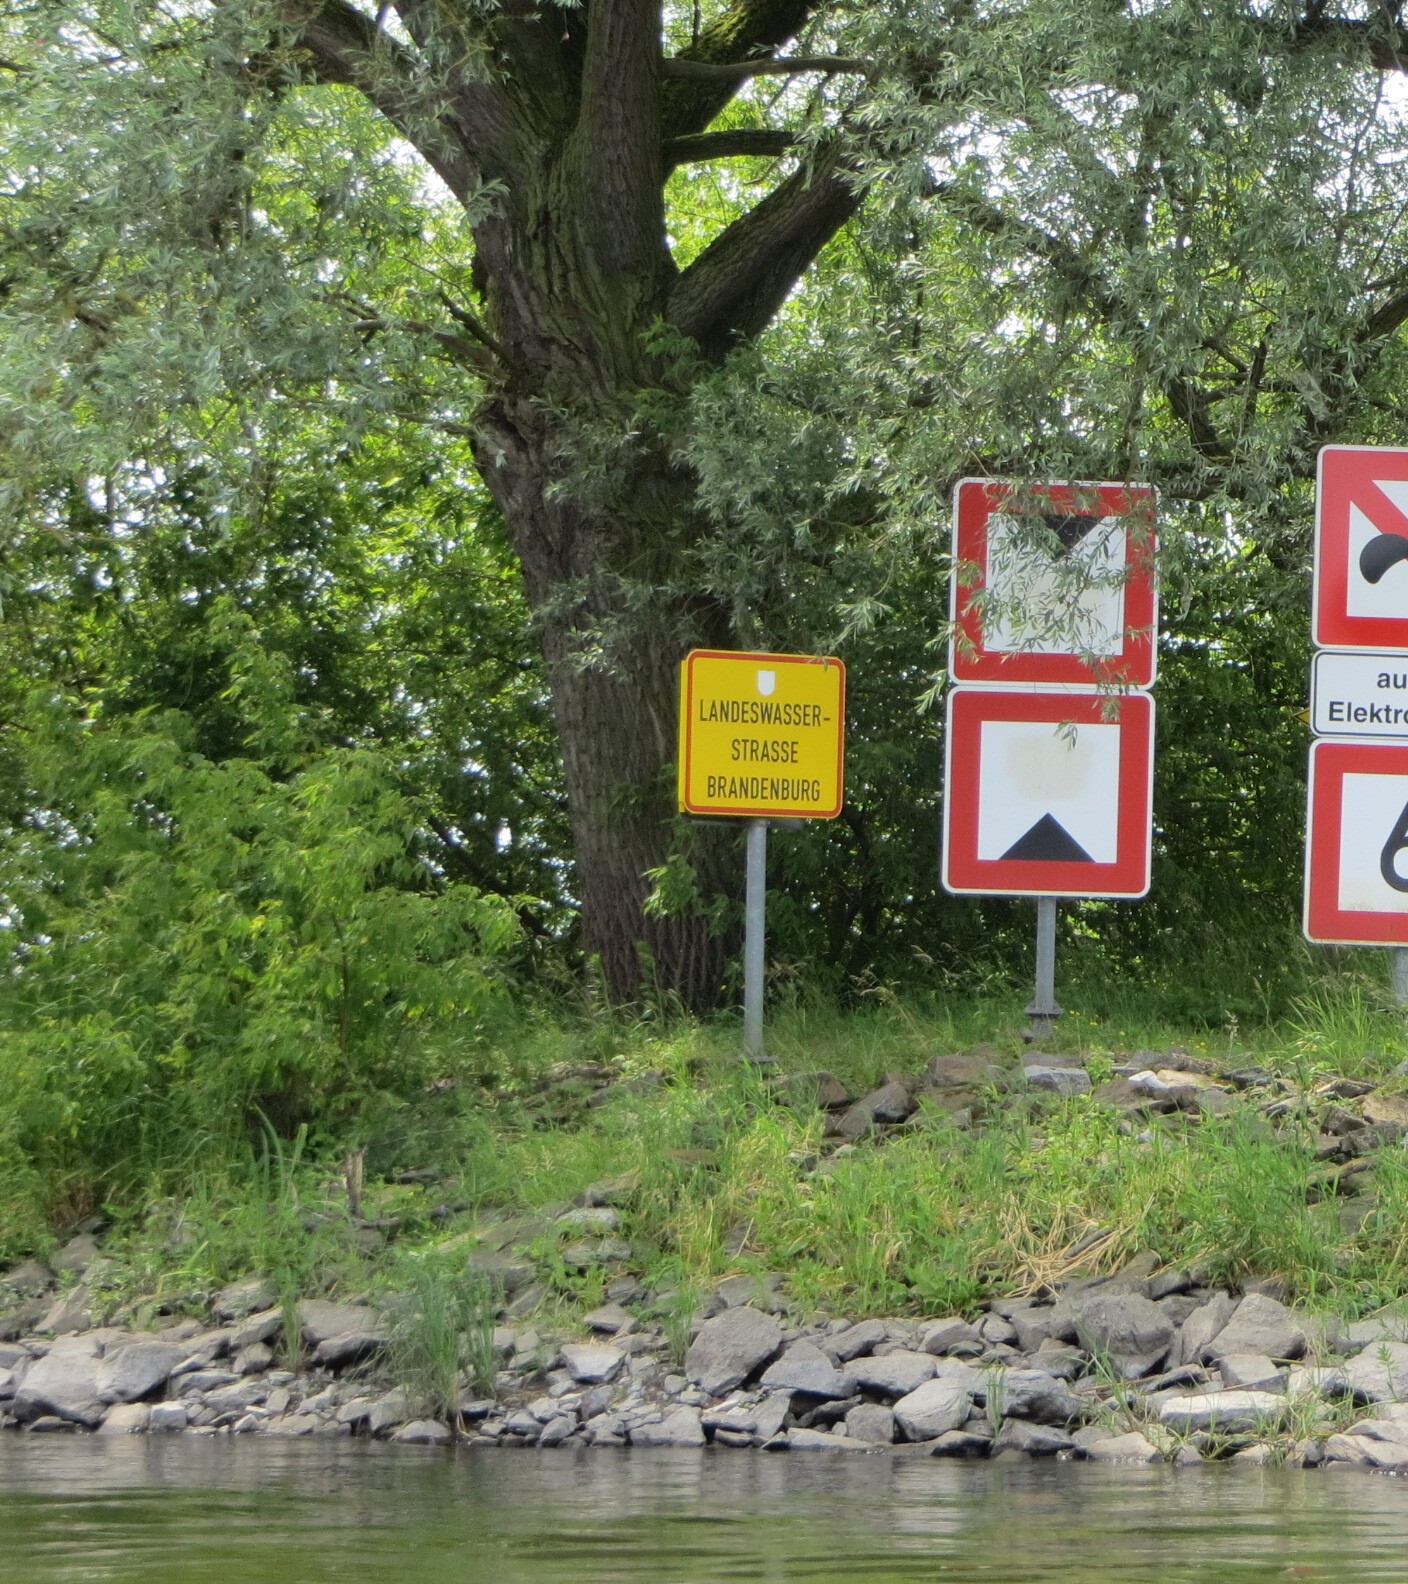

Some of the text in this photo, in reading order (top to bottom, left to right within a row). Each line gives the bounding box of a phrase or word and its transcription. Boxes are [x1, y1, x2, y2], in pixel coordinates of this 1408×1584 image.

[700, 699, 831, 727] LANDESWASSER-
[731, 738, 799, 763] STRASSE
[707, 775, 820, 802] BRANDENBURG
